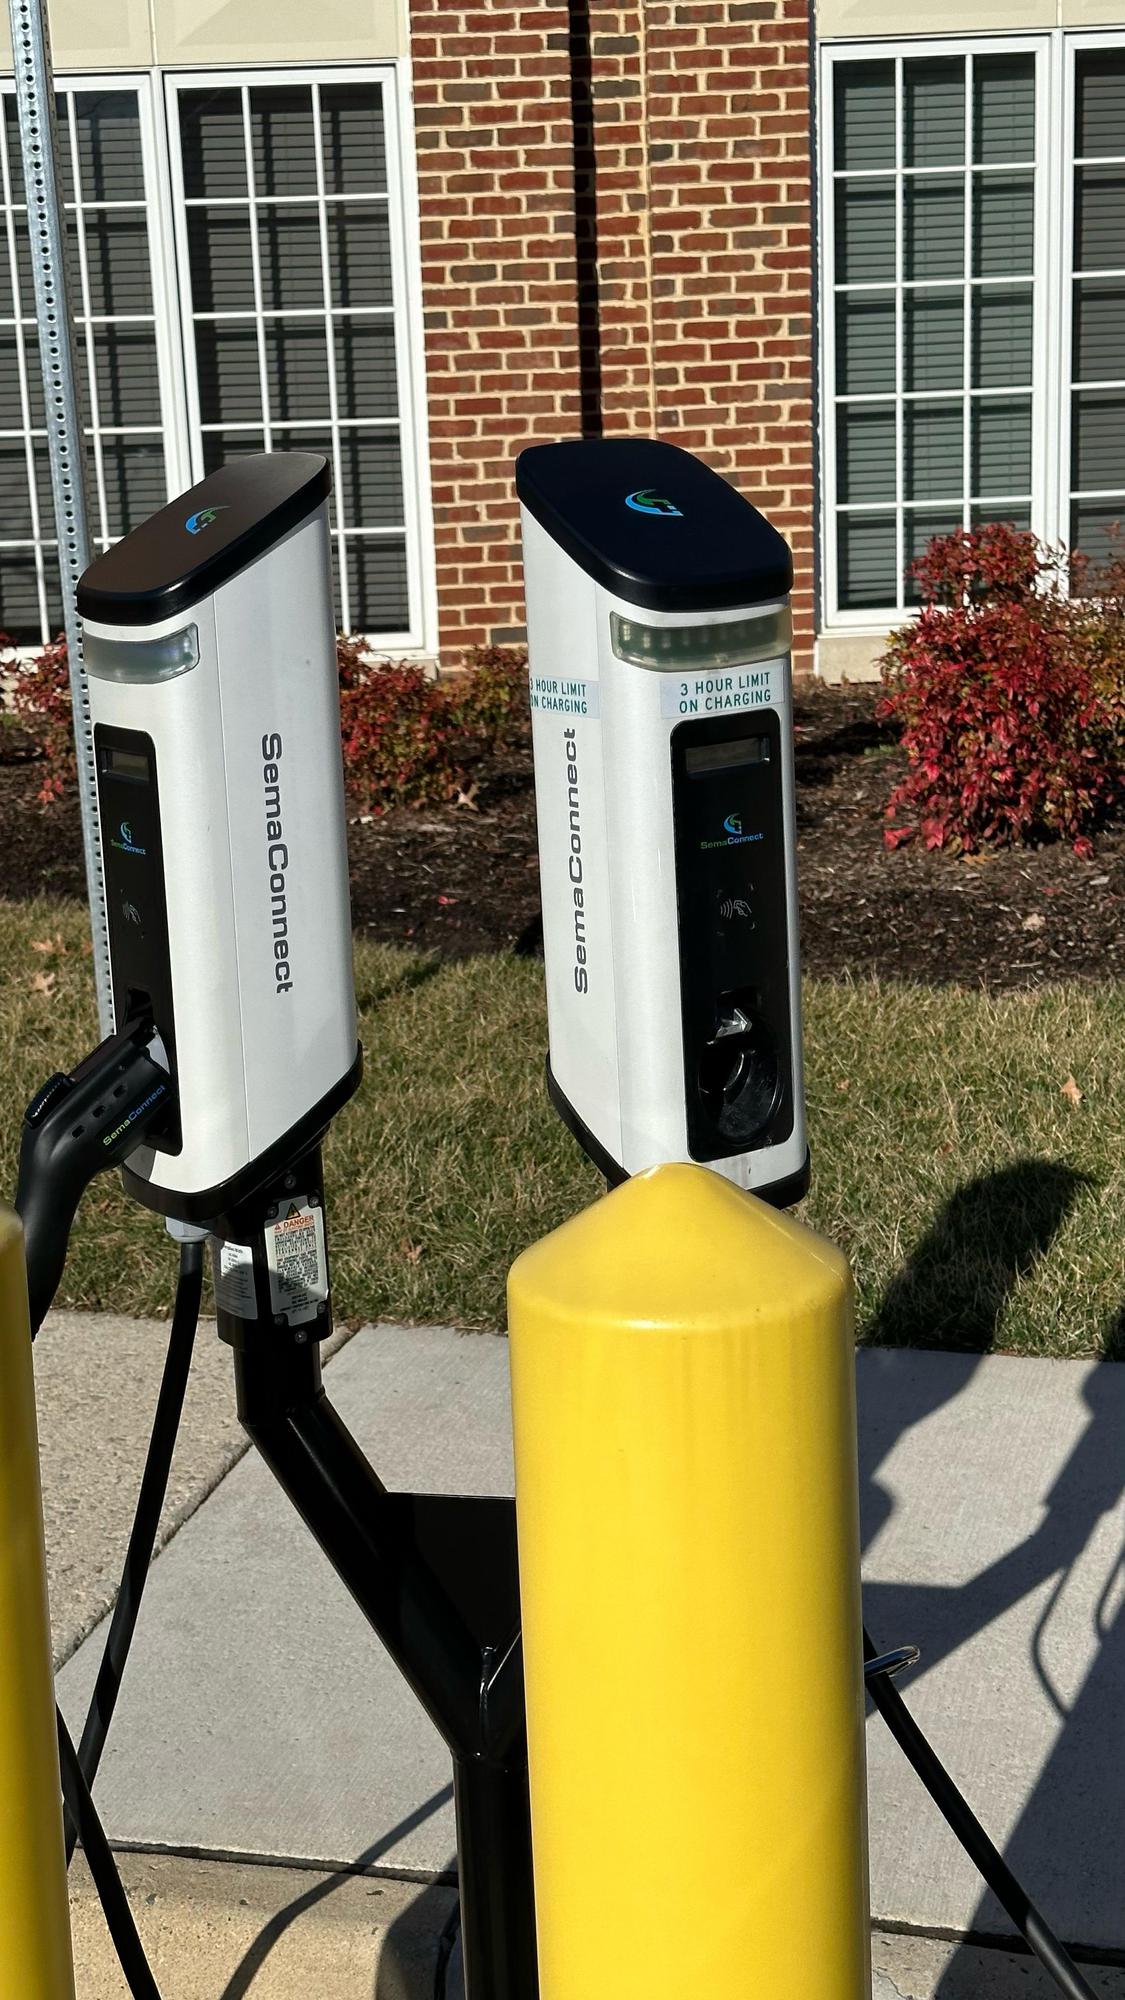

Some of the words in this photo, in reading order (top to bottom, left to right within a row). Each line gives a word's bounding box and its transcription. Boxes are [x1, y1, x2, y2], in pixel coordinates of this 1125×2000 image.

[535, 678, 558, 694] HOUR
[561, 681, 586, 697] LIMIT
[682, 683, 689, 696] 3
[695, 678, 733, 694] HOUR
[738, 672, 770, 689] LIMIT
[541, 696, 588, 714] CHARGING
[679, 699, 698, 714] ON
[705, 689, 771, 711] CHARGING
[700, 832, 764, 849] SemaConnect
[261, 732, 294, 994] SemaConnect
[563, 727, 588, 995] SemaConnect
[102, 1085, 166, 1146] SemaConnect
[283, 1214, 314, 1229] DANGER
